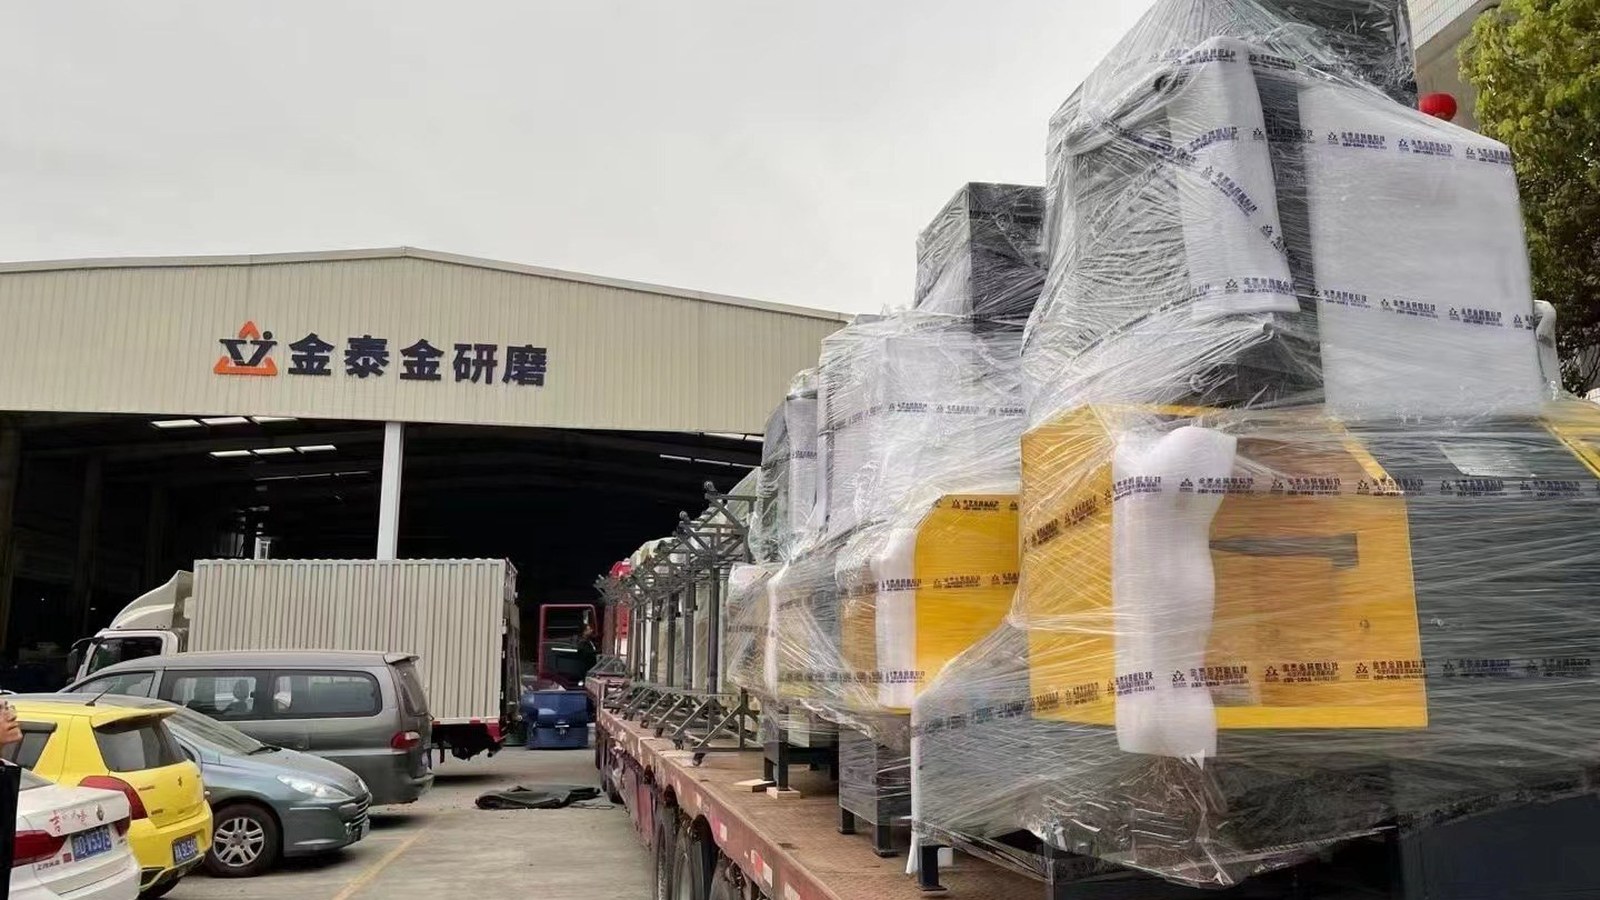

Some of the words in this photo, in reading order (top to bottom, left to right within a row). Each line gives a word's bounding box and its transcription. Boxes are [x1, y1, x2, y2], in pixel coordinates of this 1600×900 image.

[288, 332, 547, 386] 金泰金研磨
